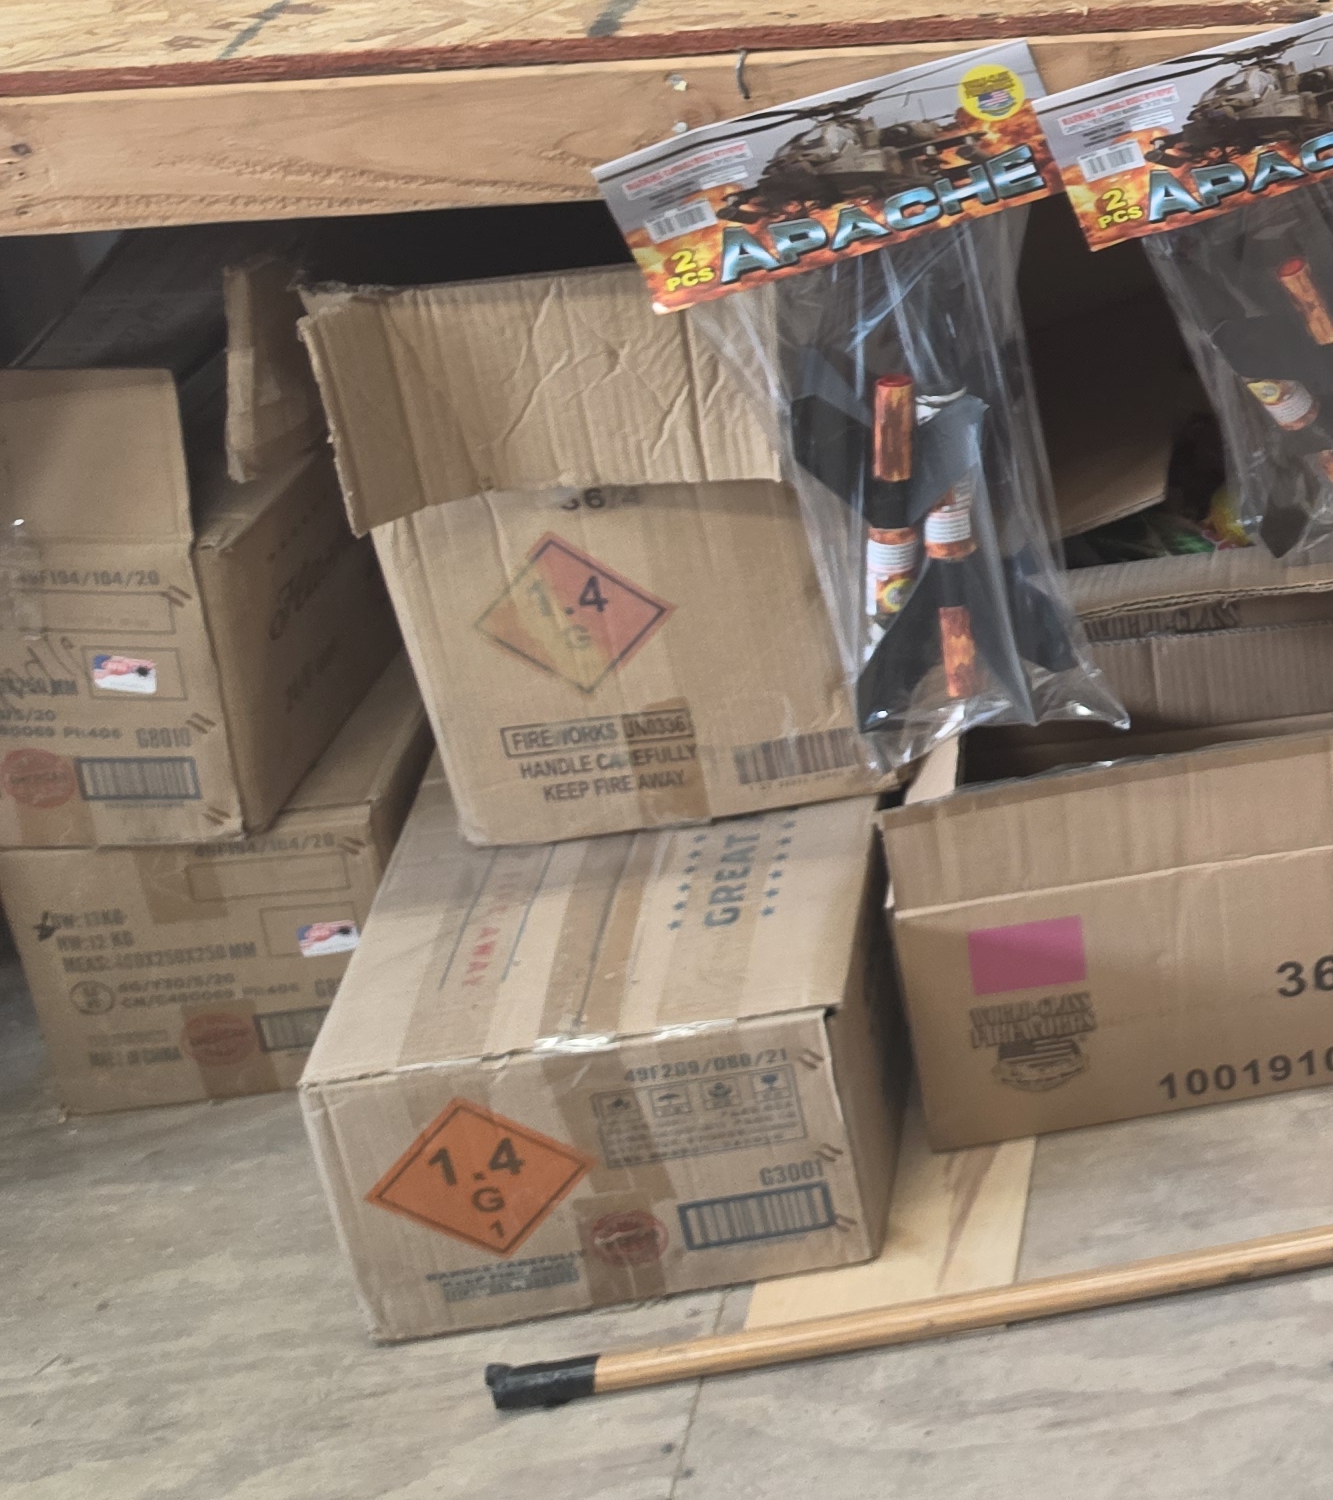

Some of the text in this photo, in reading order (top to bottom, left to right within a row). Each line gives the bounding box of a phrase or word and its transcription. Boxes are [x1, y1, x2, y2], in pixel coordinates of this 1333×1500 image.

[719, 143, 1048, 285] APACHE
[1102, 188, 1127, 213] 2
[1097, 206, 1144, 230] PCS
[670, 248, 696, 277] 2
[665, 267, 716, 293] PCS
[527, 574, 610, 618] 1.4
[519, 755, 594, 780] HANDLE
[542, 770, 686, 802] KEEP FIRE AWAY
[703, 833, 760, 930] GREAT
[426, 1136, 527, 1188] 1.4
[470, 1187, 508, 1213] G
